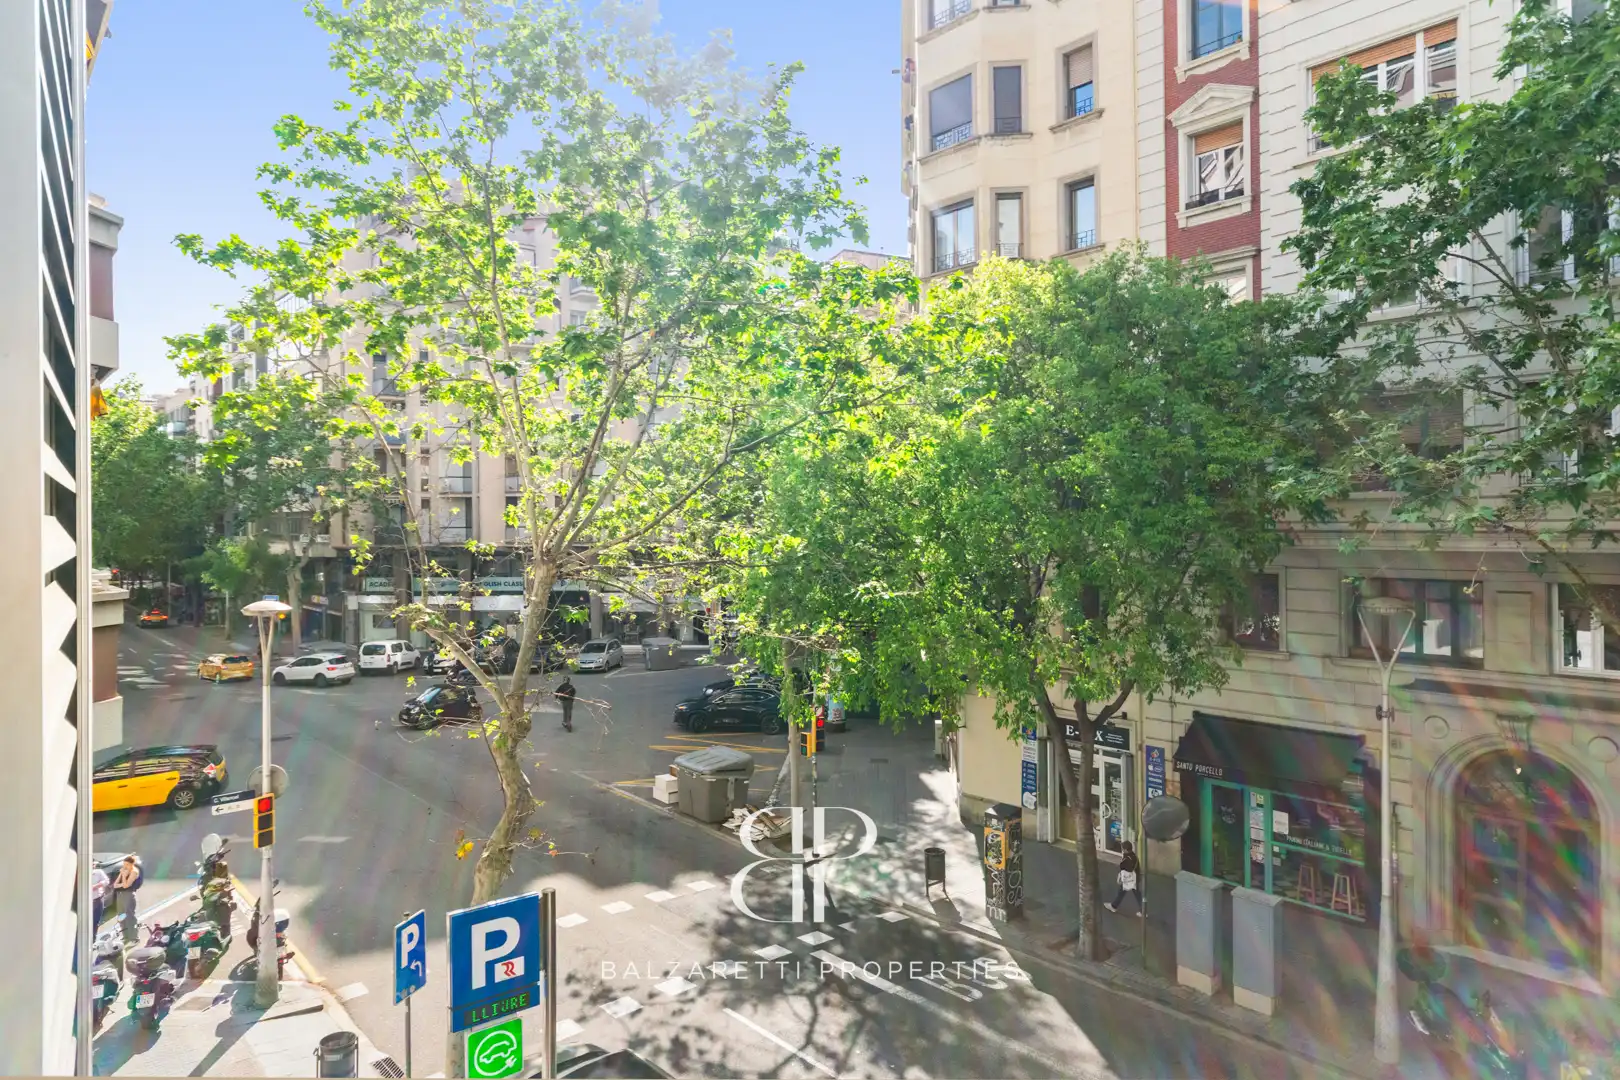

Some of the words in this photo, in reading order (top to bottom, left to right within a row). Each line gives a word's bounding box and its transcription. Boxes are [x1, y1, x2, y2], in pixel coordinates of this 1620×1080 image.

[1176, 760, 1193, 771] SANTO
[1194, 764, 1223, 776] PORCELLO
[401, 923, 420, 969] P
[471, 916, 521, 990] P
[472, 993, 527, 1022] LLIURE
